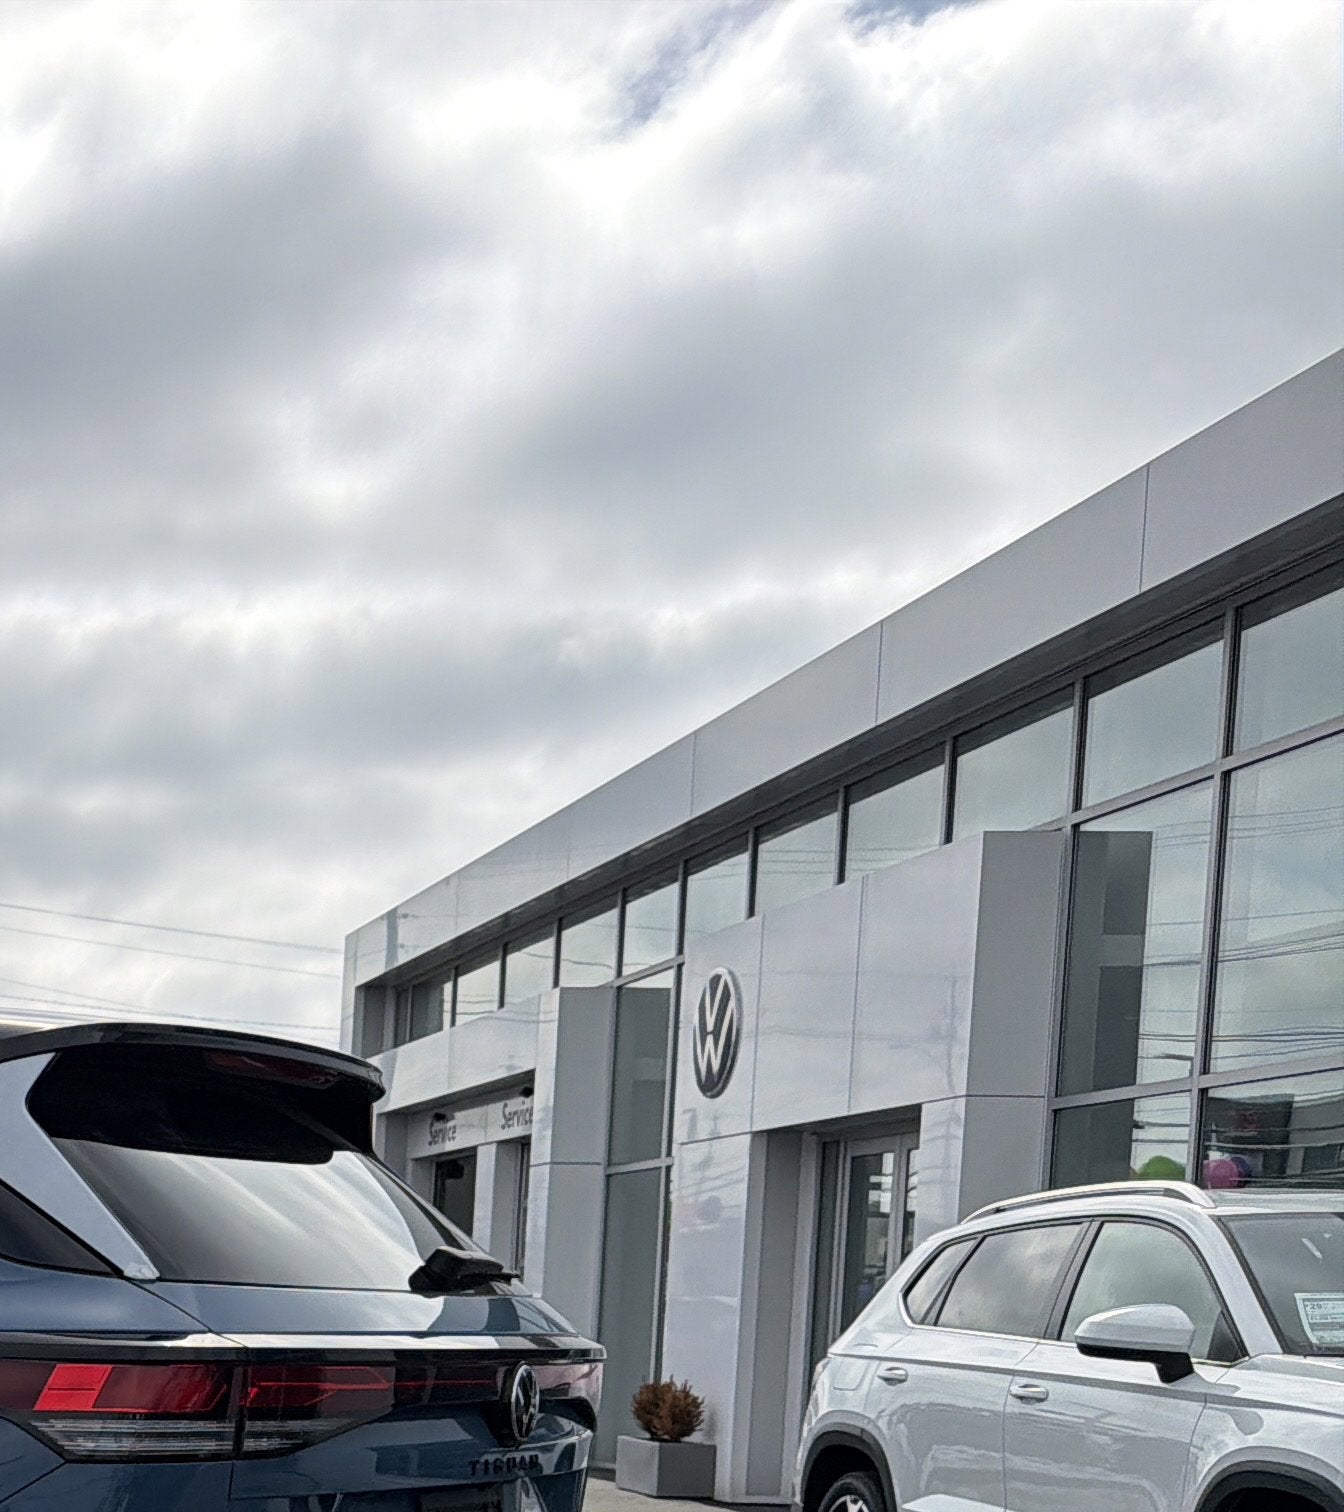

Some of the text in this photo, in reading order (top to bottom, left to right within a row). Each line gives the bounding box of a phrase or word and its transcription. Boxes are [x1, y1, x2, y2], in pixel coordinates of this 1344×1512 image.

[694, 968, 740, 1097] VW
[502, 1101, 533, 1130] Service
[428, 1119, 457, 1146] Service
